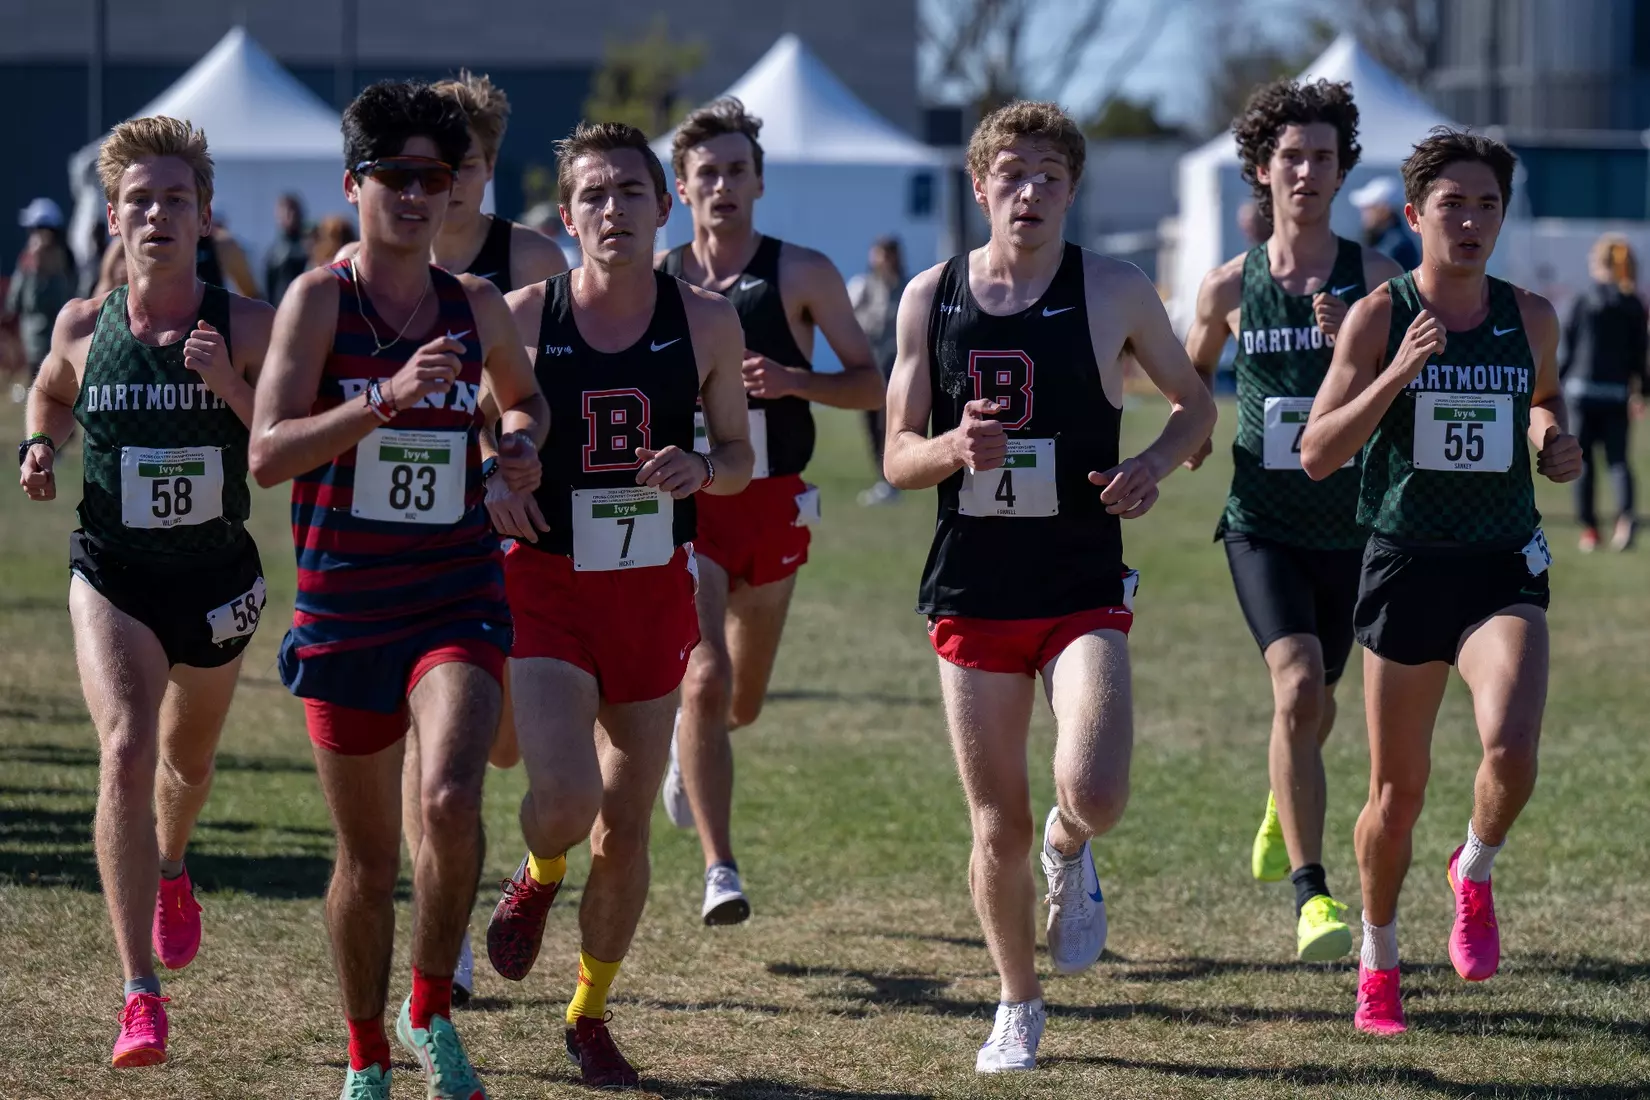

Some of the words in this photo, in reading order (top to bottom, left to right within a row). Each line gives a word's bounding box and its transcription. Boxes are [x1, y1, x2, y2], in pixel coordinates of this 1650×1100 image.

[545, 344, 563, 357] Ivy
[968, 350, 1034, 430] B
[1404, 365, 1529, 393] ARTMOUTH
[582, 388, 651, 472] B
[1453, 409, 1469, 419] Ivy
[403, 449, 421, 461] Ivy
[1444, 422, 1485, 462] 55
[159, 465, 175, 475] Ivy
[389, 464, 437, 511] 83
[994, 469, 1017, 508] 4
[151, 477, 193, 518] 58
[613, 504, 630, 516] Ivy
[617, 518, 636, 559] 7
[1535, 533, 1552, 565] 5
[230, 593, 259, 632] 58
